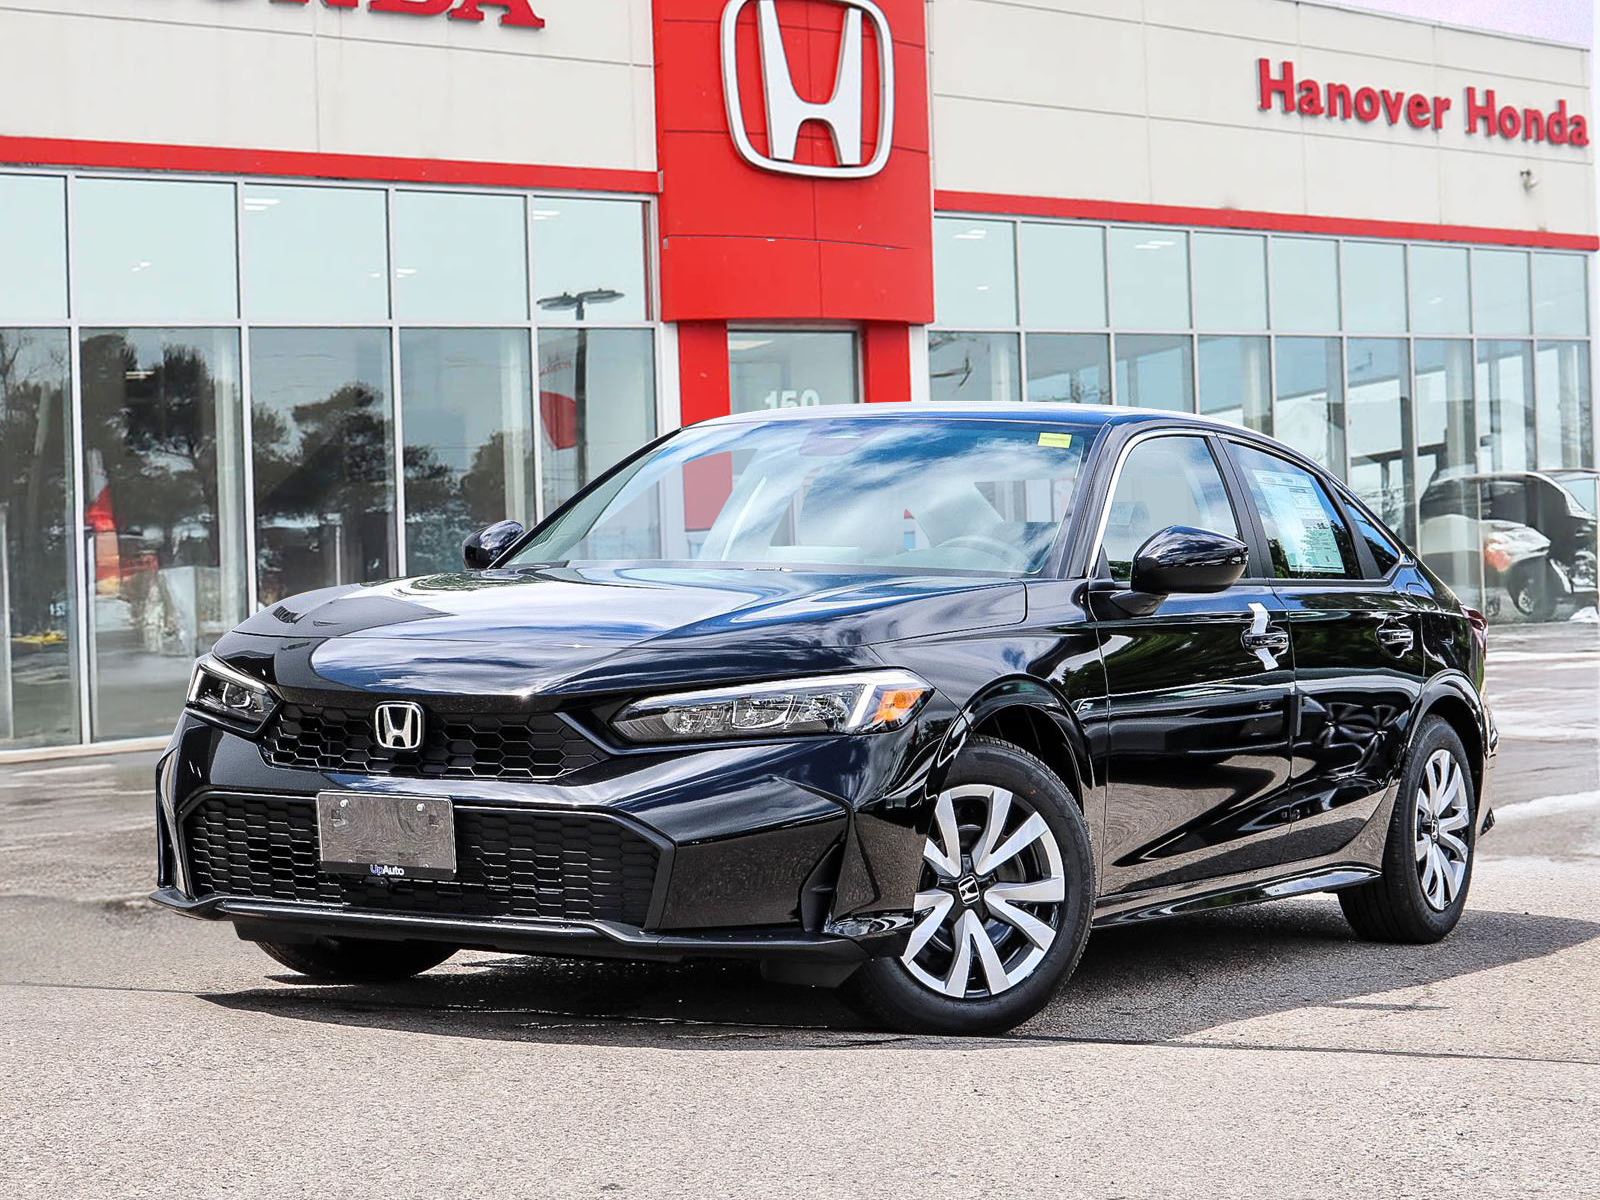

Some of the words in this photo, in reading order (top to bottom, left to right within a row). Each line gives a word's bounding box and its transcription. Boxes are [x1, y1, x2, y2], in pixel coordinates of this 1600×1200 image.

[1257, 58, 1452, 130] Hanover
[1465, 86, 1590, 147] Honda
[764, 388, 821, 410] 150
[369, 863, 405, 877] UpAuto
